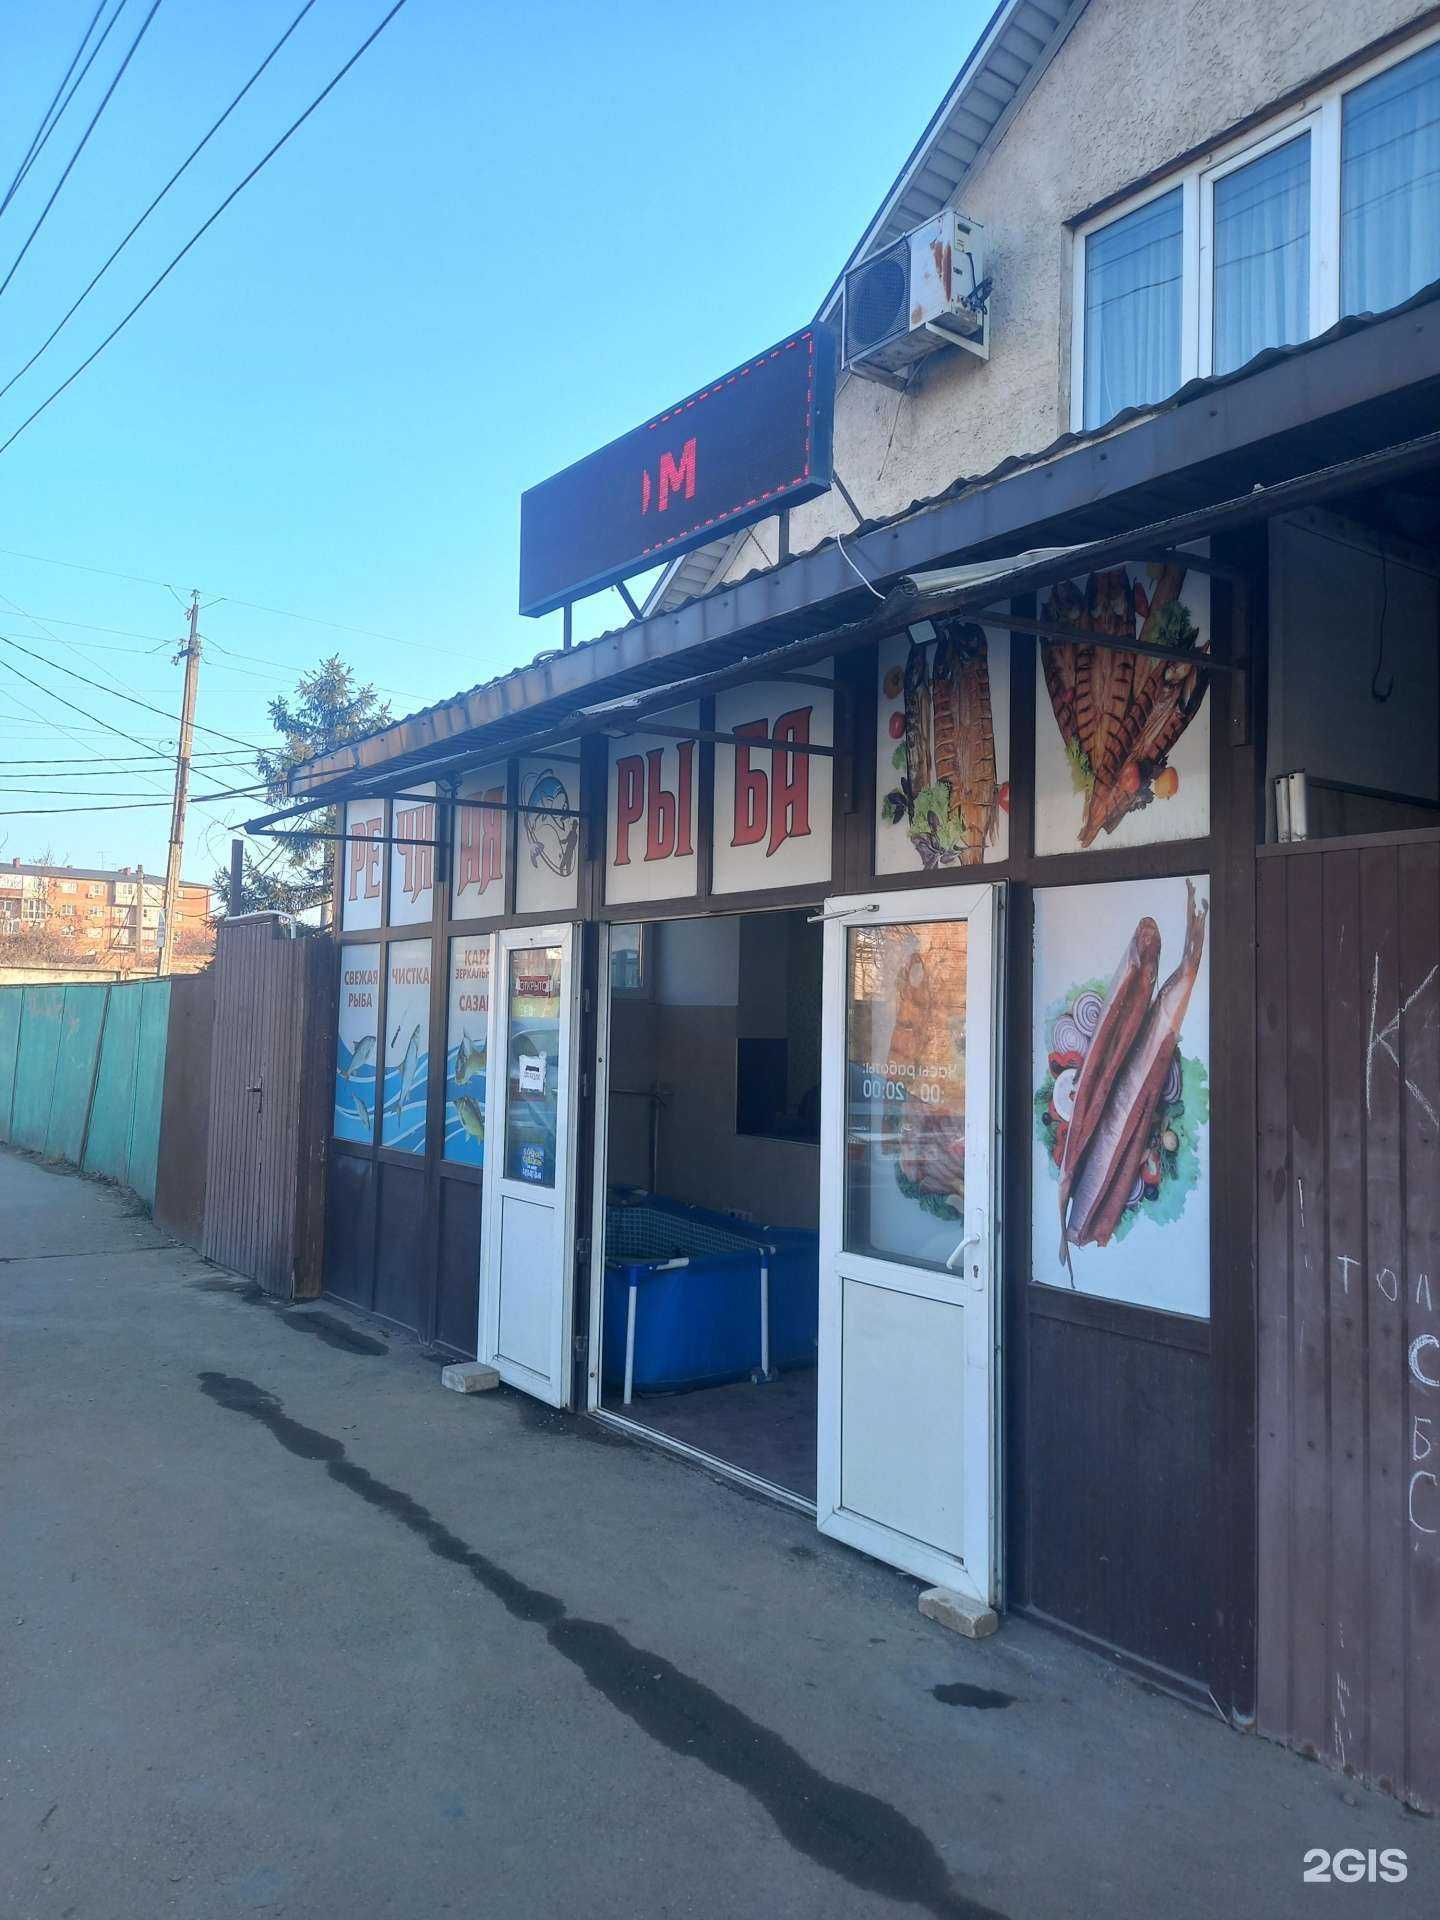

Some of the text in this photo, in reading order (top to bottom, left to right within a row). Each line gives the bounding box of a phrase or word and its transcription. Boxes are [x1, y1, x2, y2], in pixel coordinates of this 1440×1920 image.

[613, 706, 813, 867] РЫБА
[344, 970, 378, 986] СВЕЖАЯ
[392, 967, 430, 985] ЧИСТКА
[348, 992, 373, 1008] РЫБА
